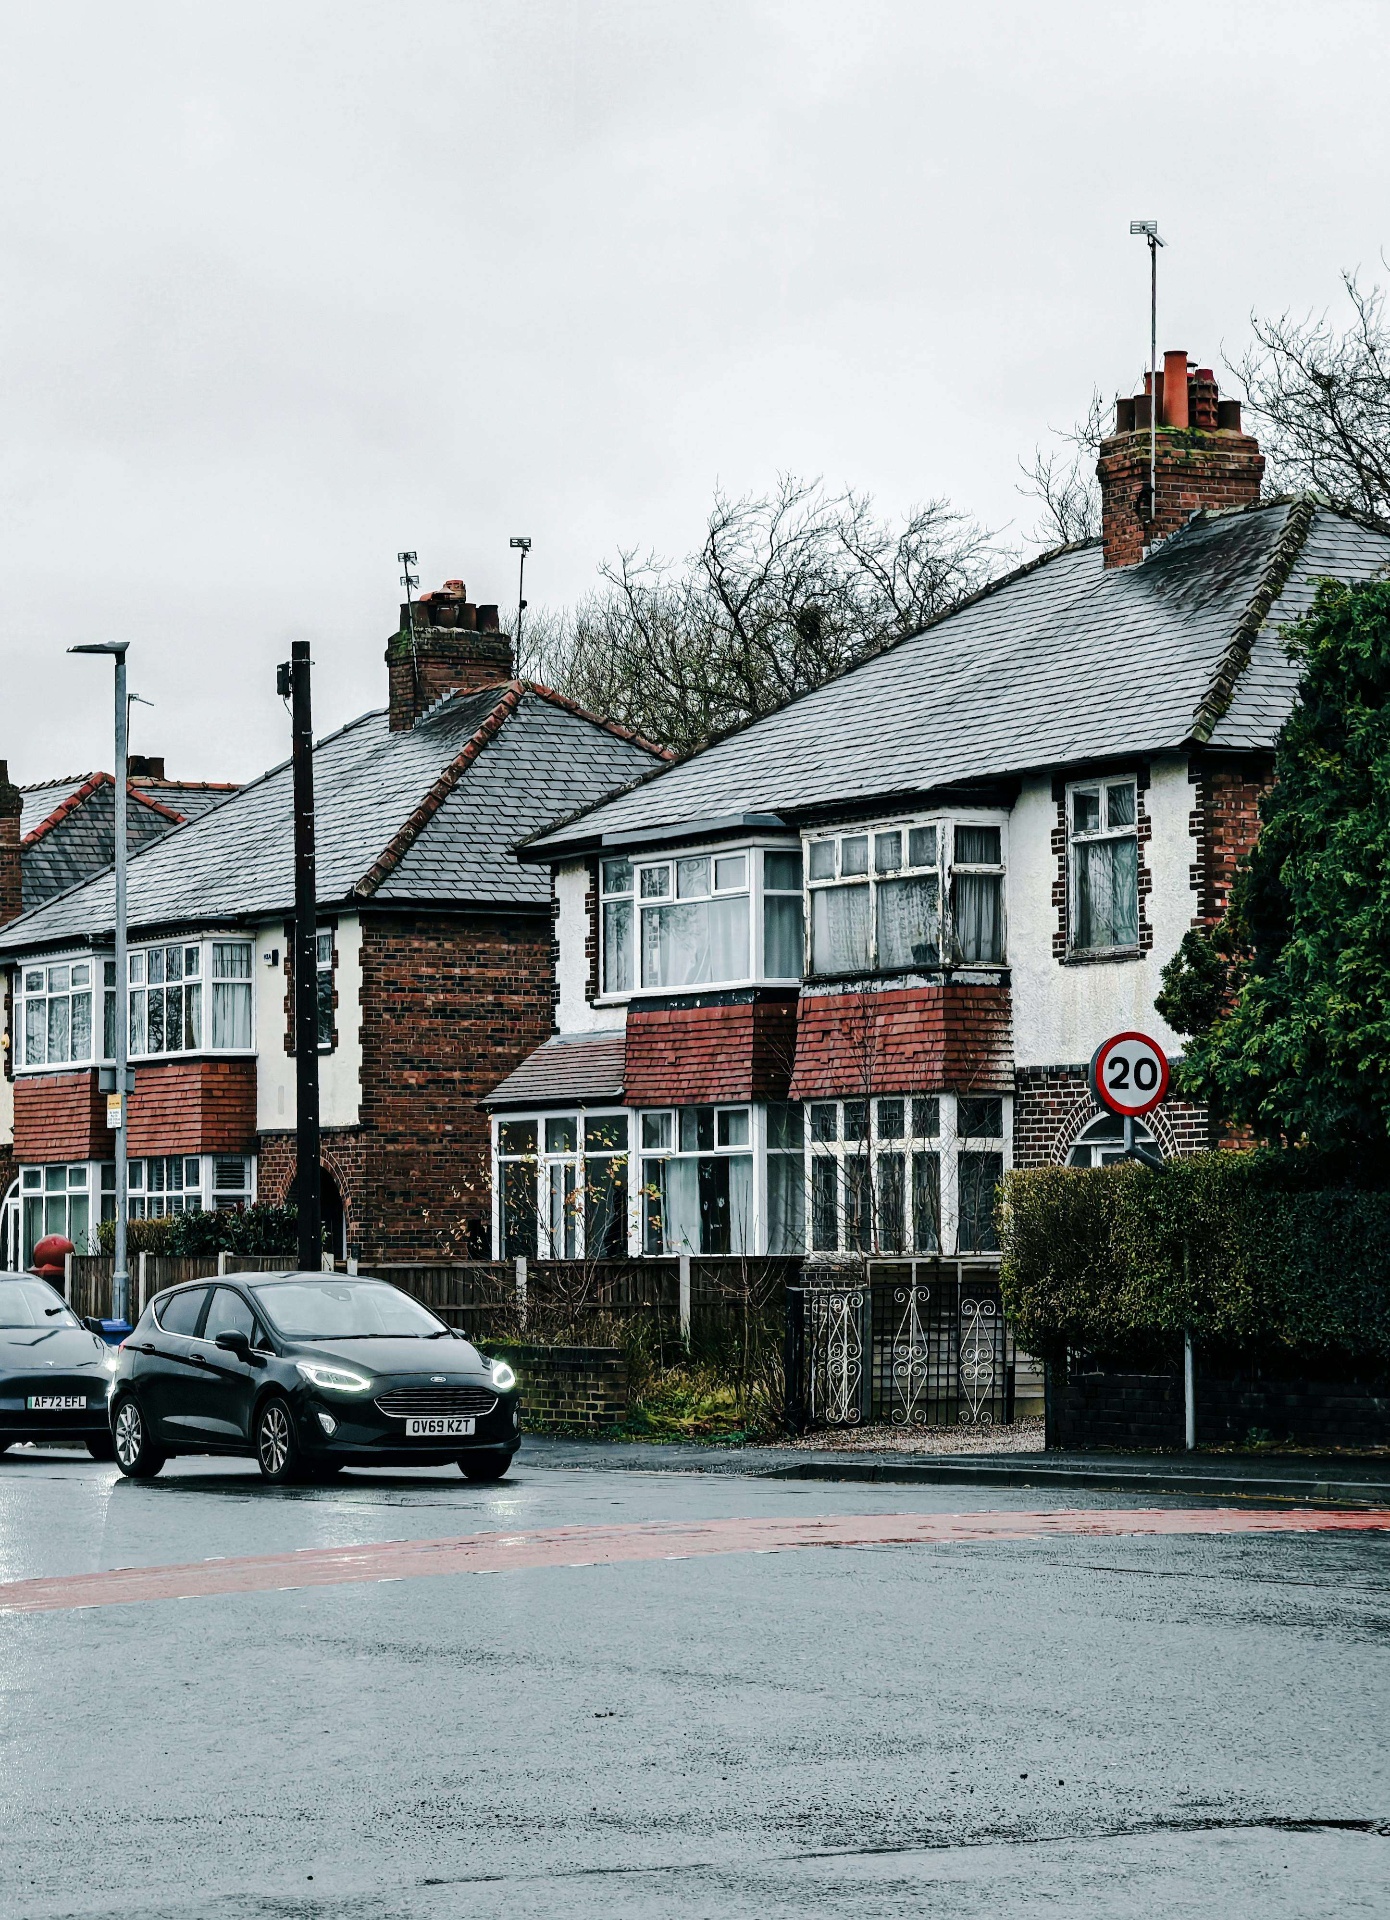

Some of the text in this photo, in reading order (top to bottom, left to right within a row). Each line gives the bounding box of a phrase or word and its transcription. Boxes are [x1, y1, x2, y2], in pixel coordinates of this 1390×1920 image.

[1108, 1056, 1158, 1091] 20
[34, 1396, 85, 1408] AF72 EFL
[412, 1419, 470, 1434] OV69 KZT
